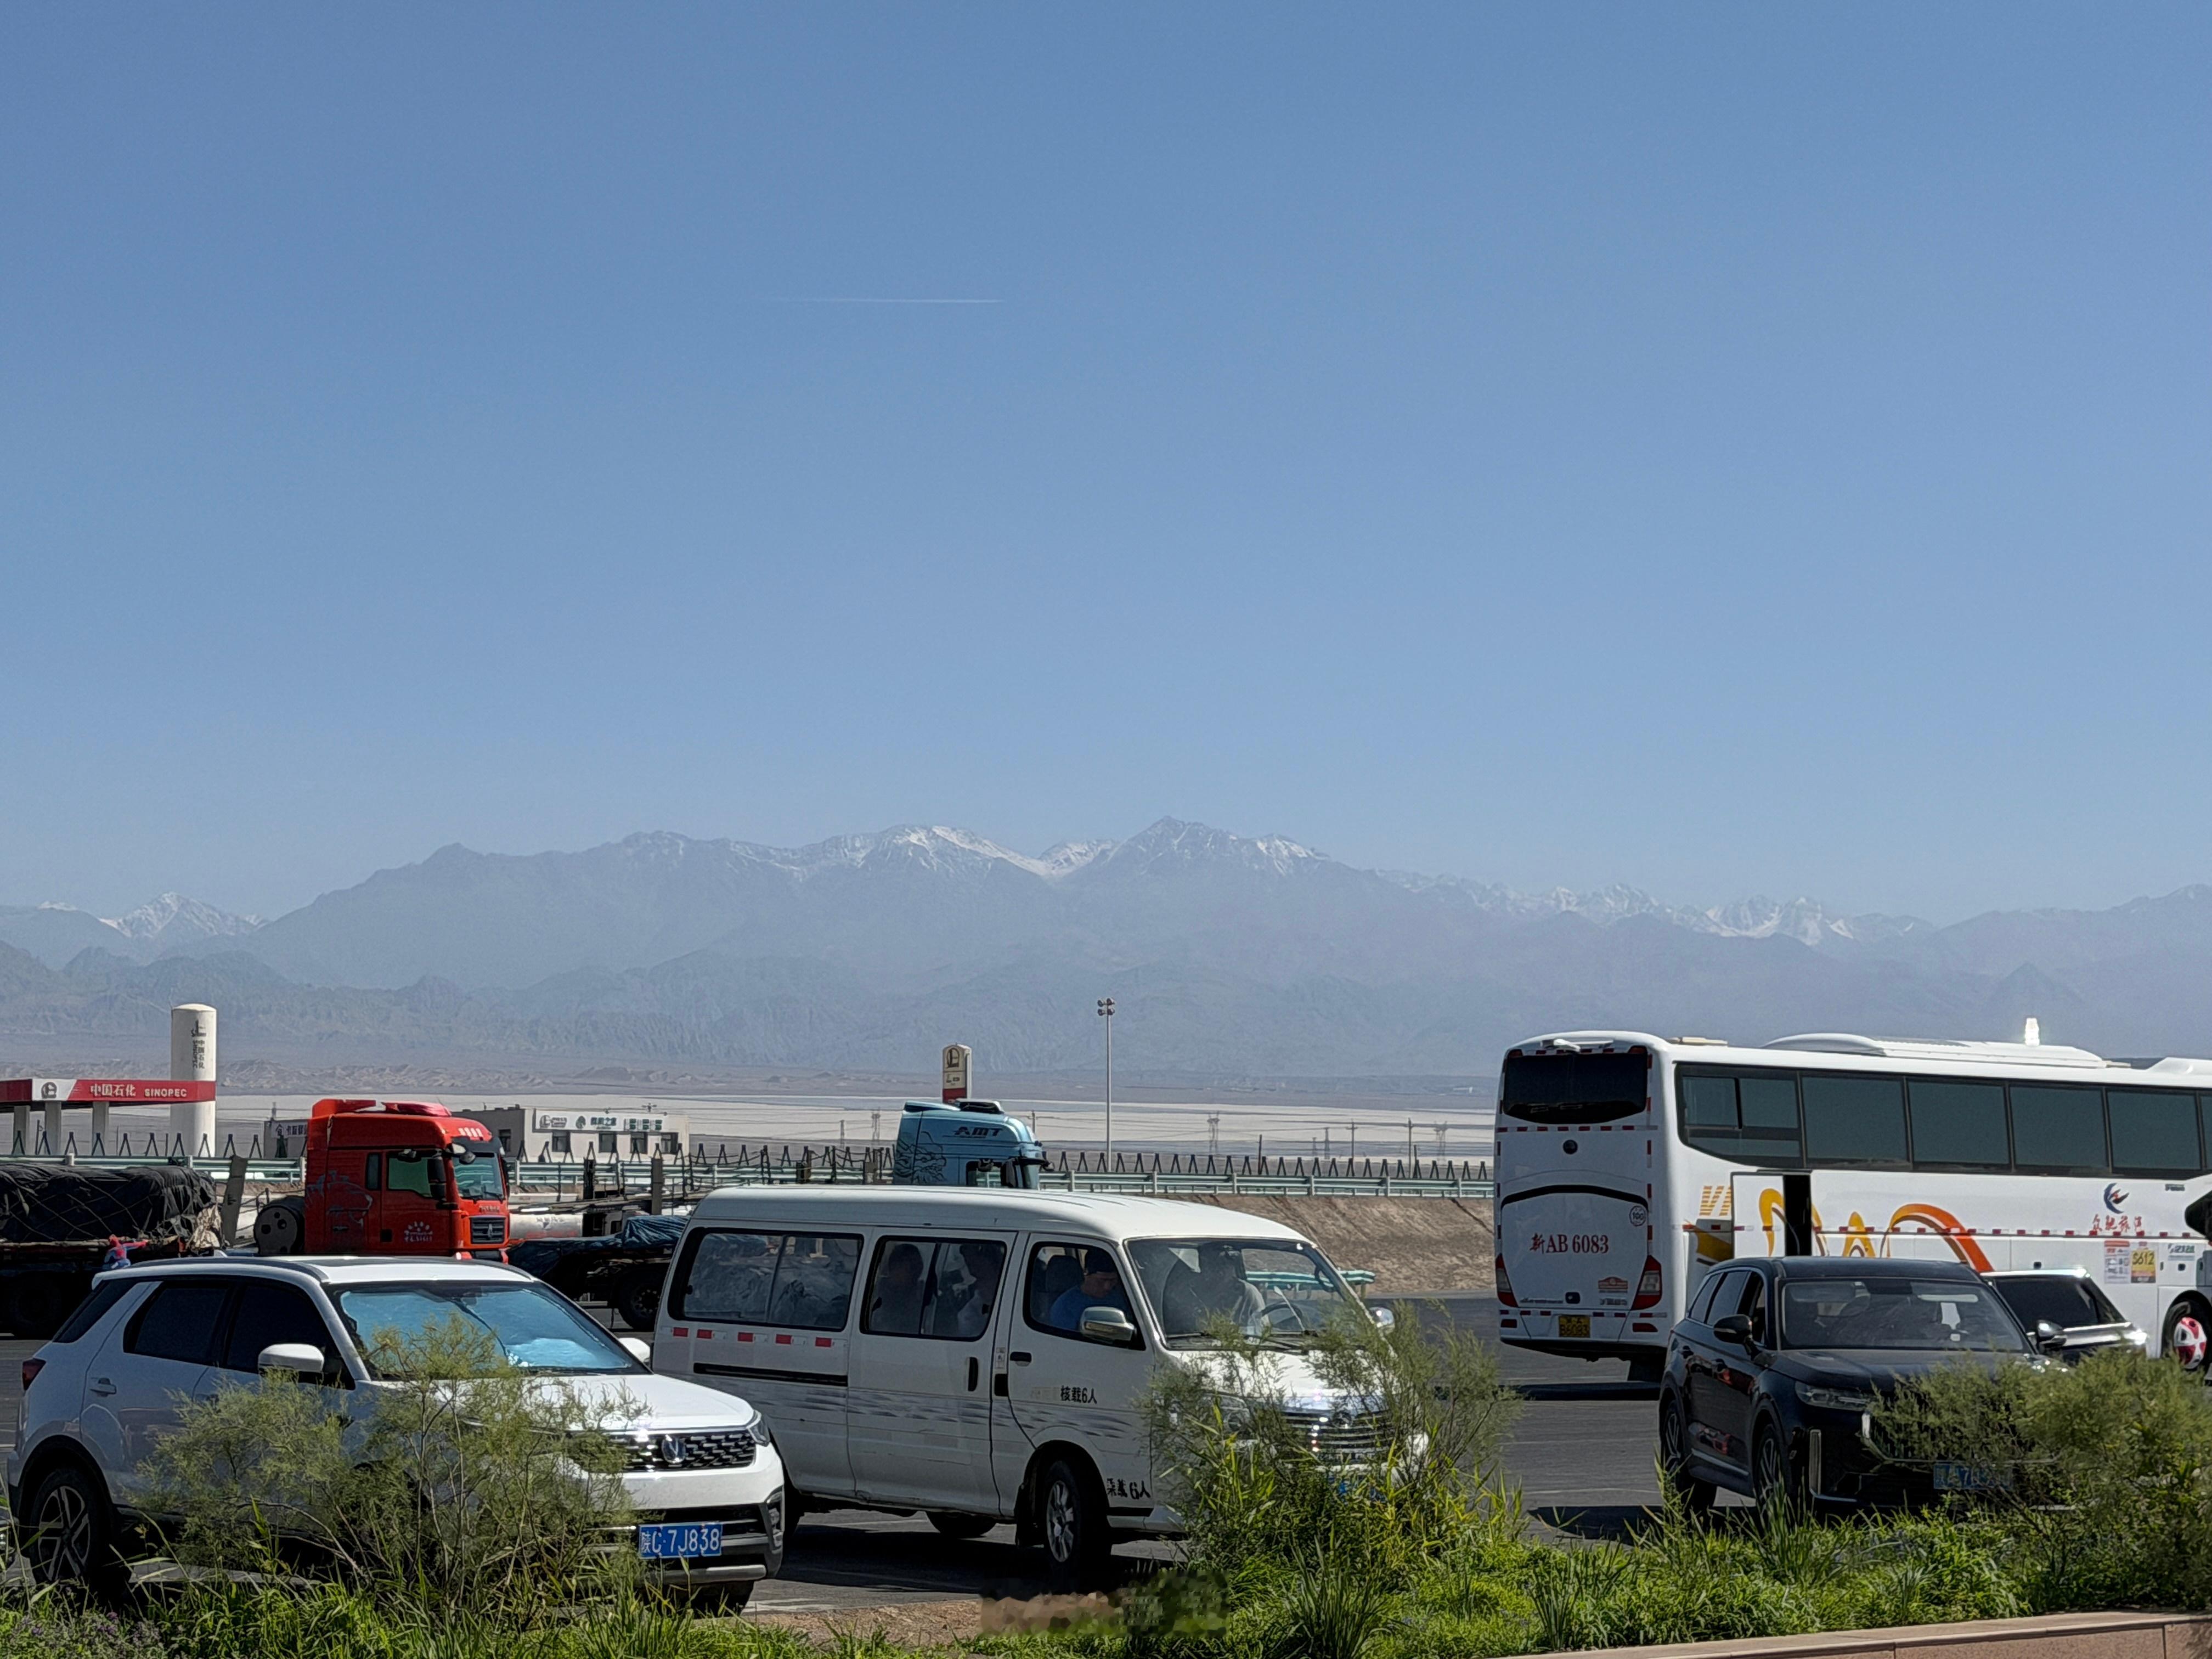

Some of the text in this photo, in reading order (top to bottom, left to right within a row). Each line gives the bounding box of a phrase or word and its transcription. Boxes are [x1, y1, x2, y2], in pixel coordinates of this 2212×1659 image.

[91, 1084, 187, 1097] 中国石化 SINOPEC
[1530, 1233, 1609, 1254] 新AB 6083
[1060, 1385, 1097, 1404] 核载6人
